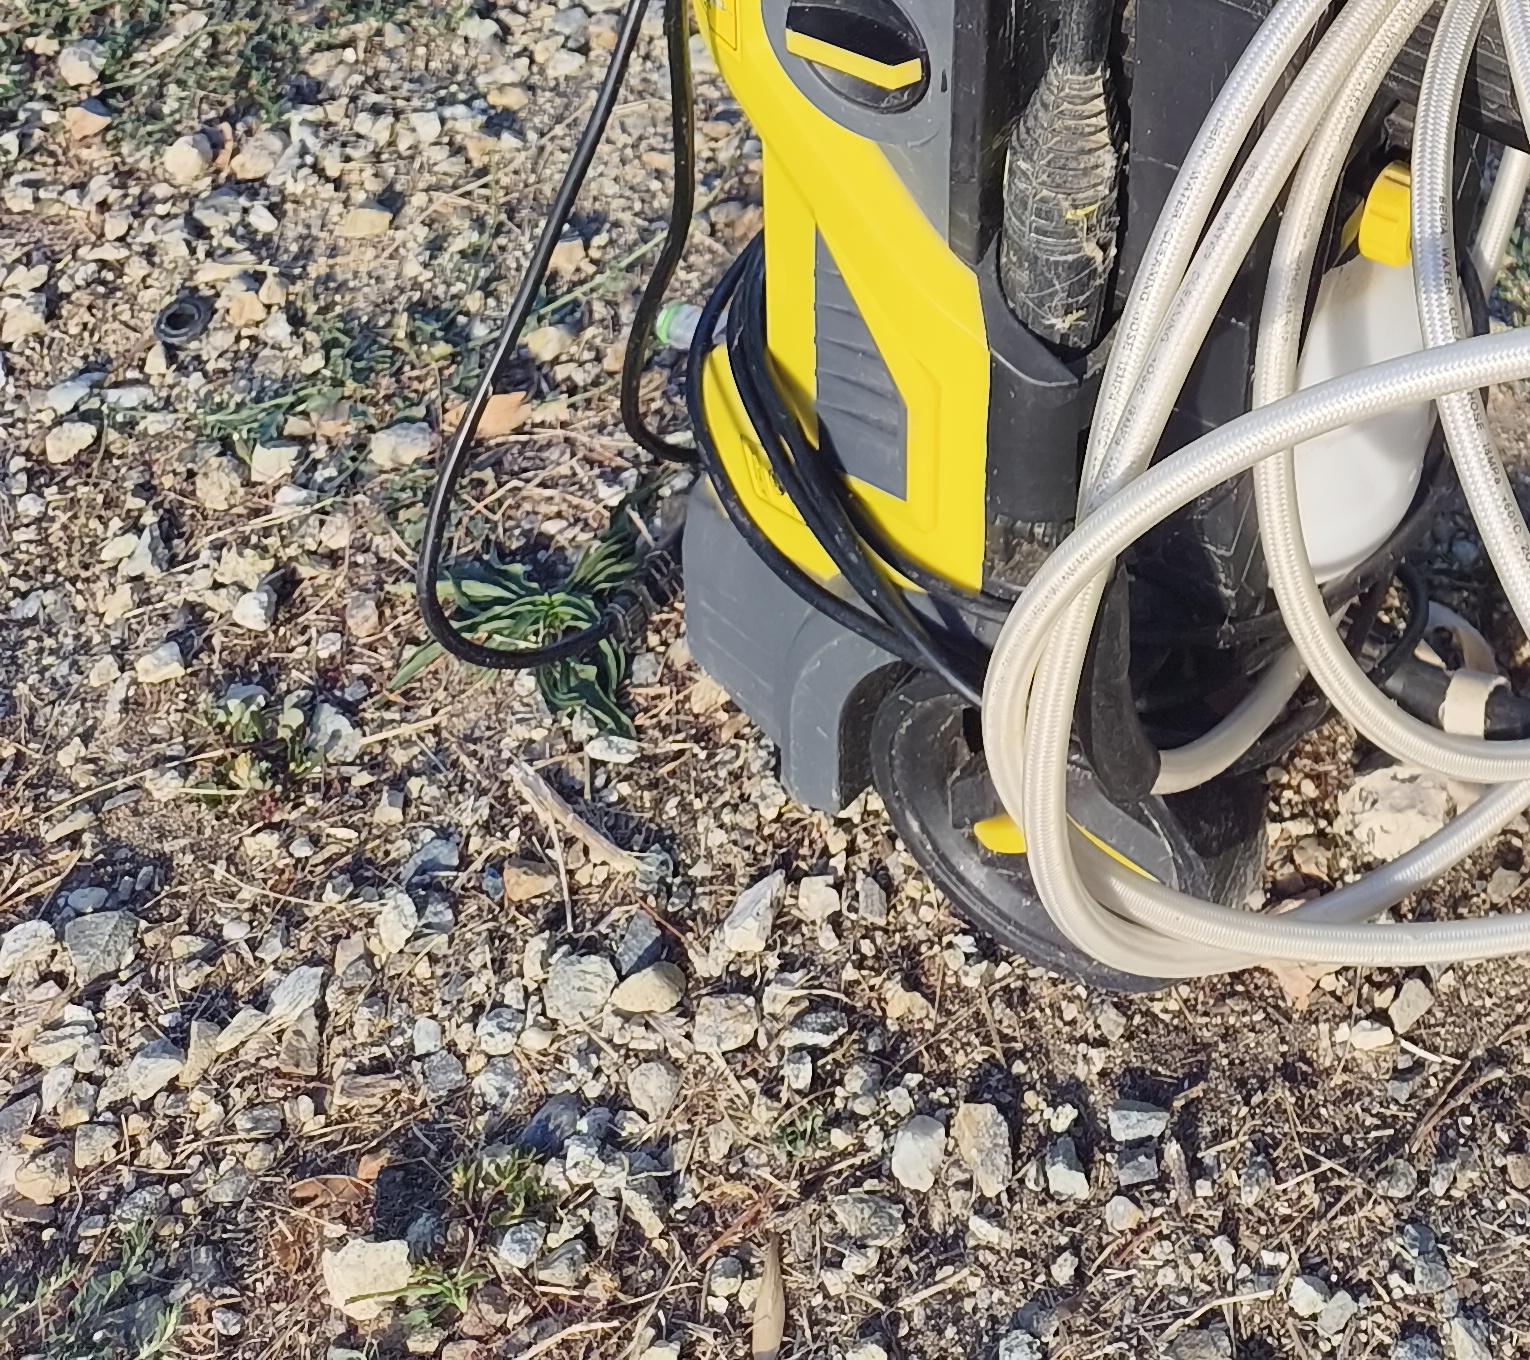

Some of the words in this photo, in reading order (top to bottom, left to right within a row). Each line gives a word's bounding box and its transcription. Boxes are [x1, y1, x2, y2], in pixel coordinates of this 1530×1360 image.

[1436, 195, 1448, 234] BEIDA
[1439, 246, 1455, 296] WATER
[1466, 391, 1484, 431] HOSE
